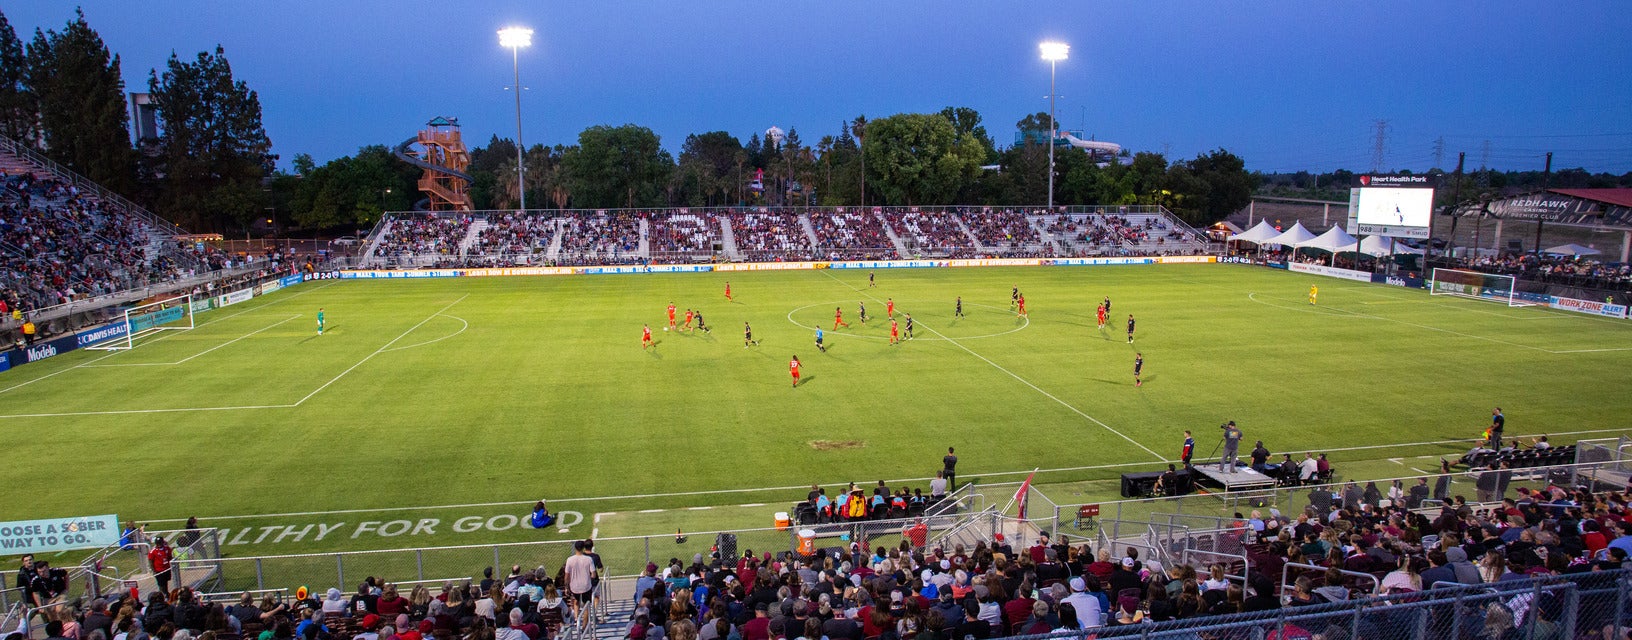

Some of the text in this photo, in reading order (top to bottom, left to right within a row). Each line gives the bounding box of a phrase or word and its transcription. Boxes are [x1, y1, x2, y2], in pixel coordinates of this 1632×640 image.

[1510, 200, 1568, 208] REDHAWK
[1386, 276, 1405, 287] Modelo
[1559, 298, 1581, 308] WORK
[1581, 302, 1602, 310] ZONE
[107, 322, 132, 338] HEALTH
[28, 345, 56, 362] Modelo
[0, 525, 41, 537] OOSE
[46, 524, 57, 534] A
[351, 518, 440, 539] FOR
[0, 534, 91, 548] WAY TO GO.
